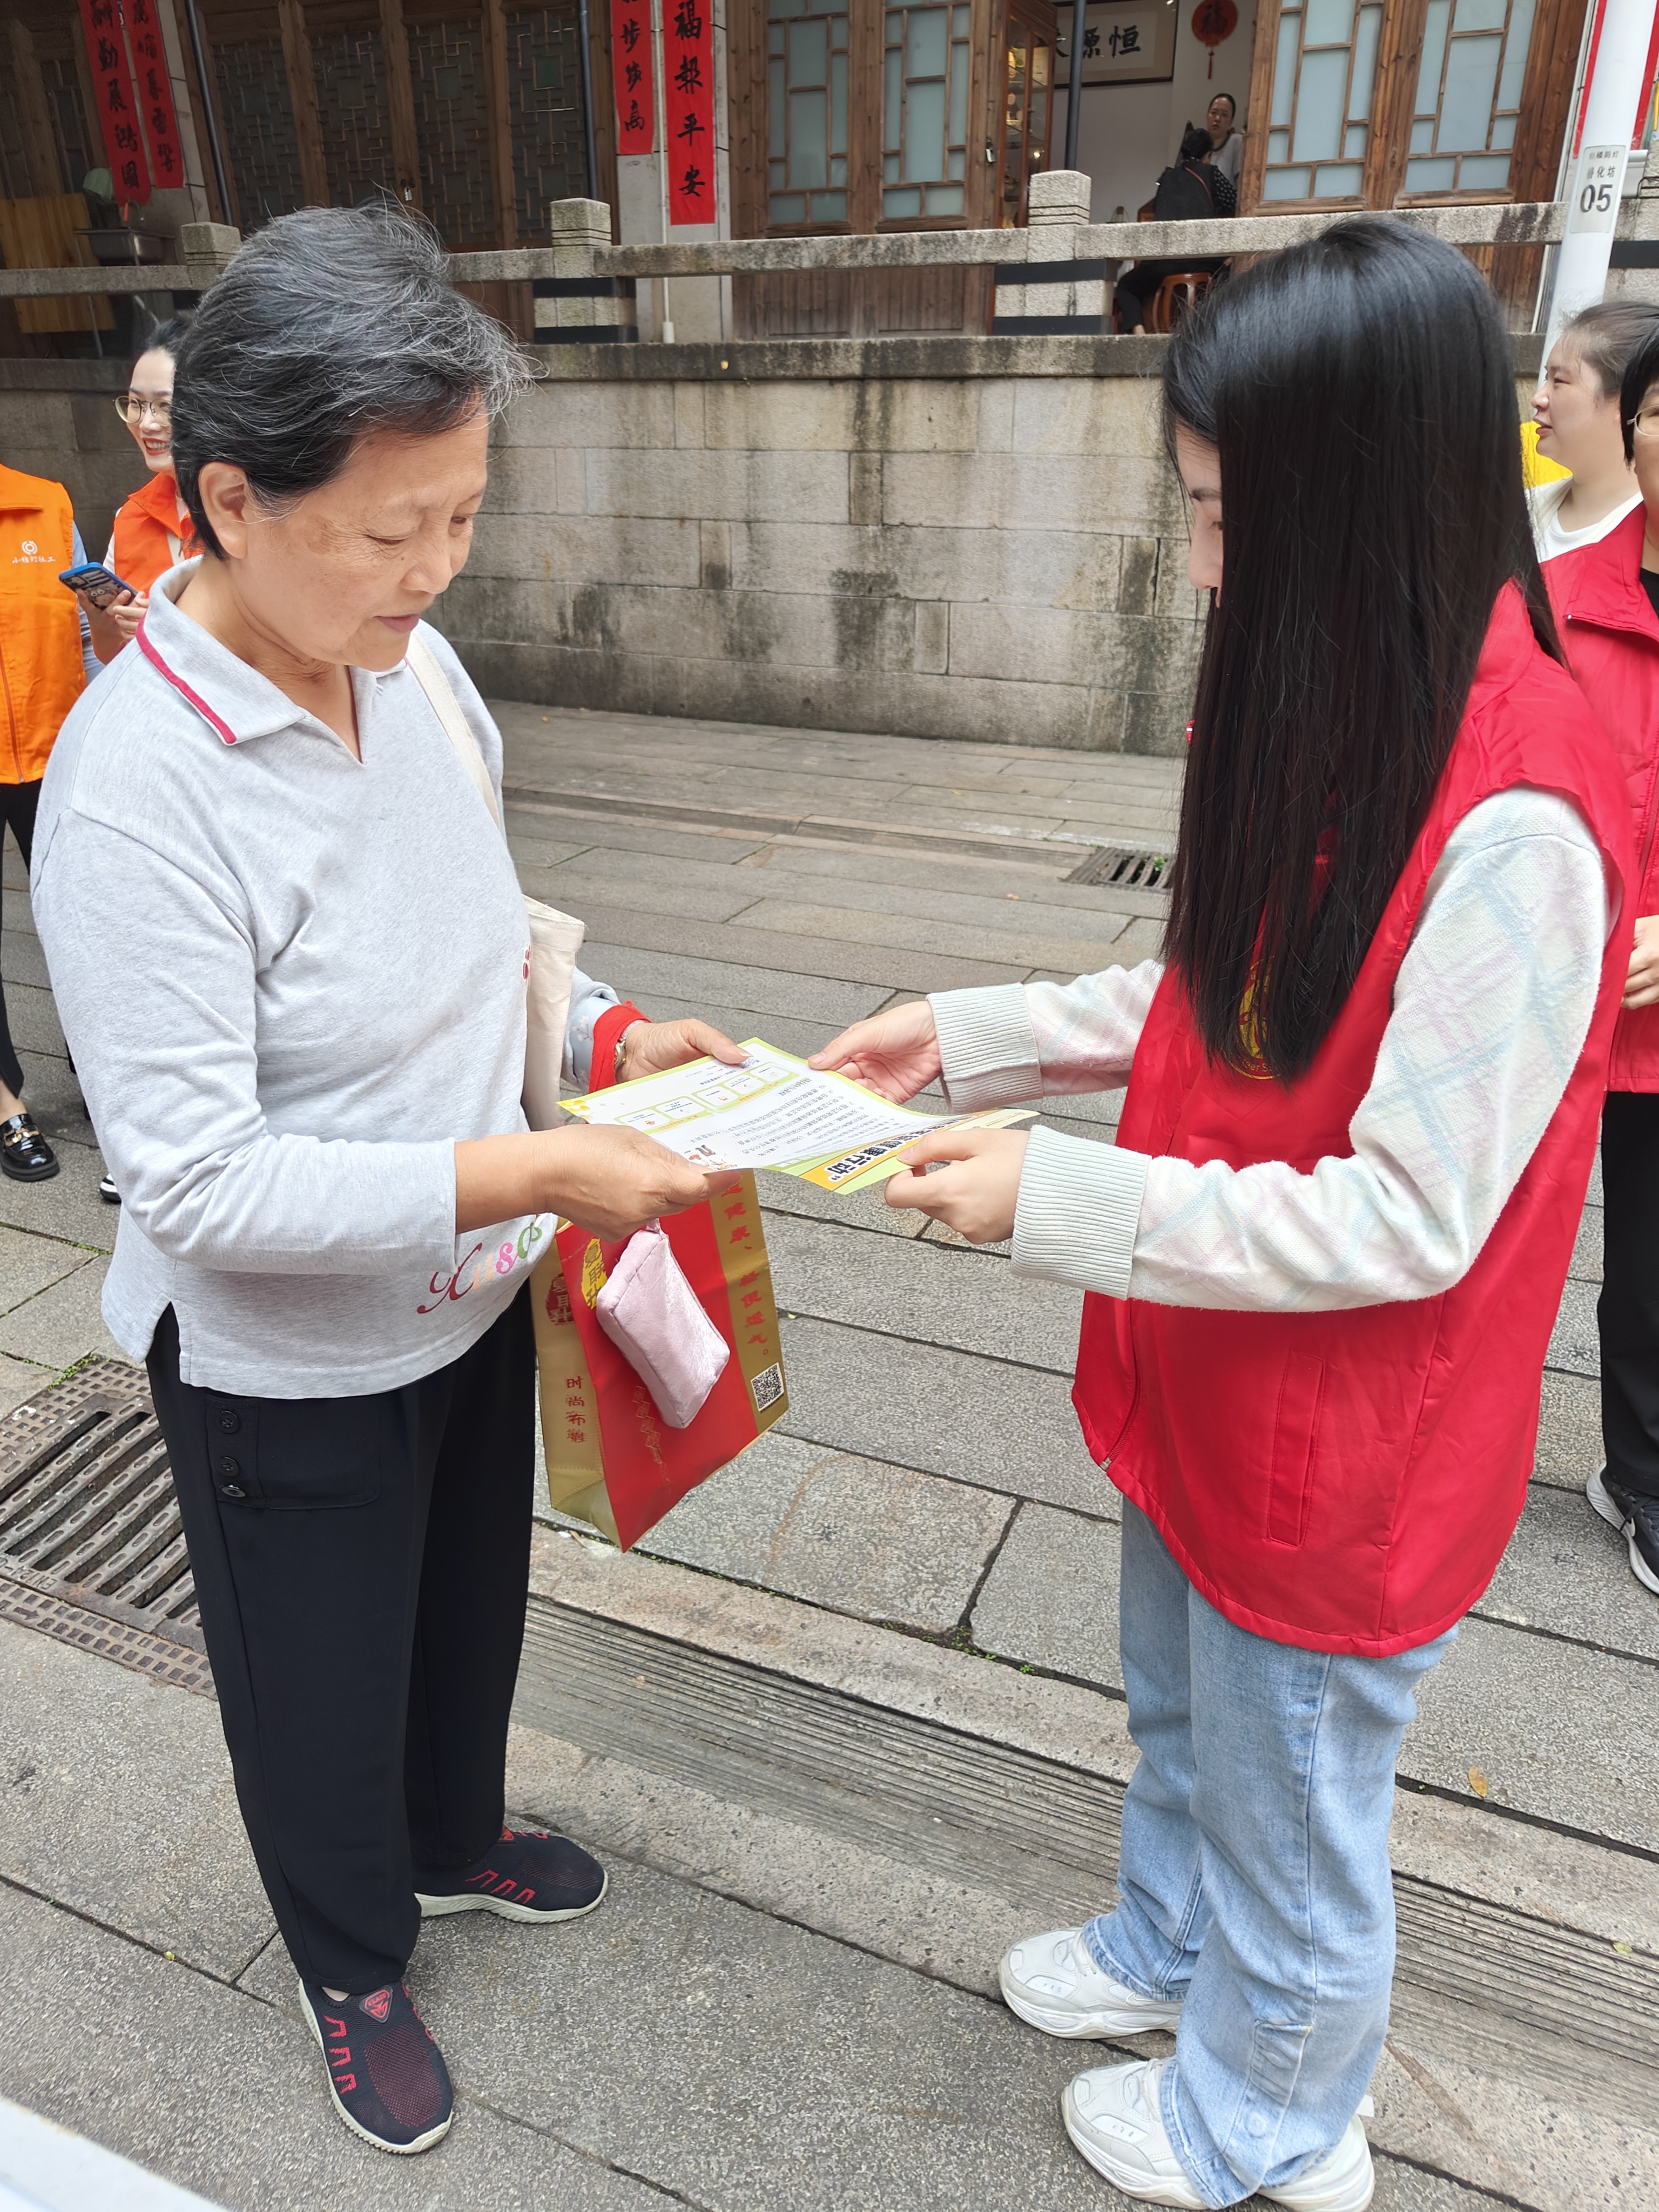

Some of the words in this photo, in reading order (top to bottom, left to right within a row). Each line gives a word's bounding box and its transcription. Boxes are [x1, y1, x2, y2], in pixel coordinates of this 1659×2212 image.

[620, 0, 645, 132] 步步高
[1580, 184, 1613, 213] 05
[565, 1375, 588, 1444] 时尚布鞋
